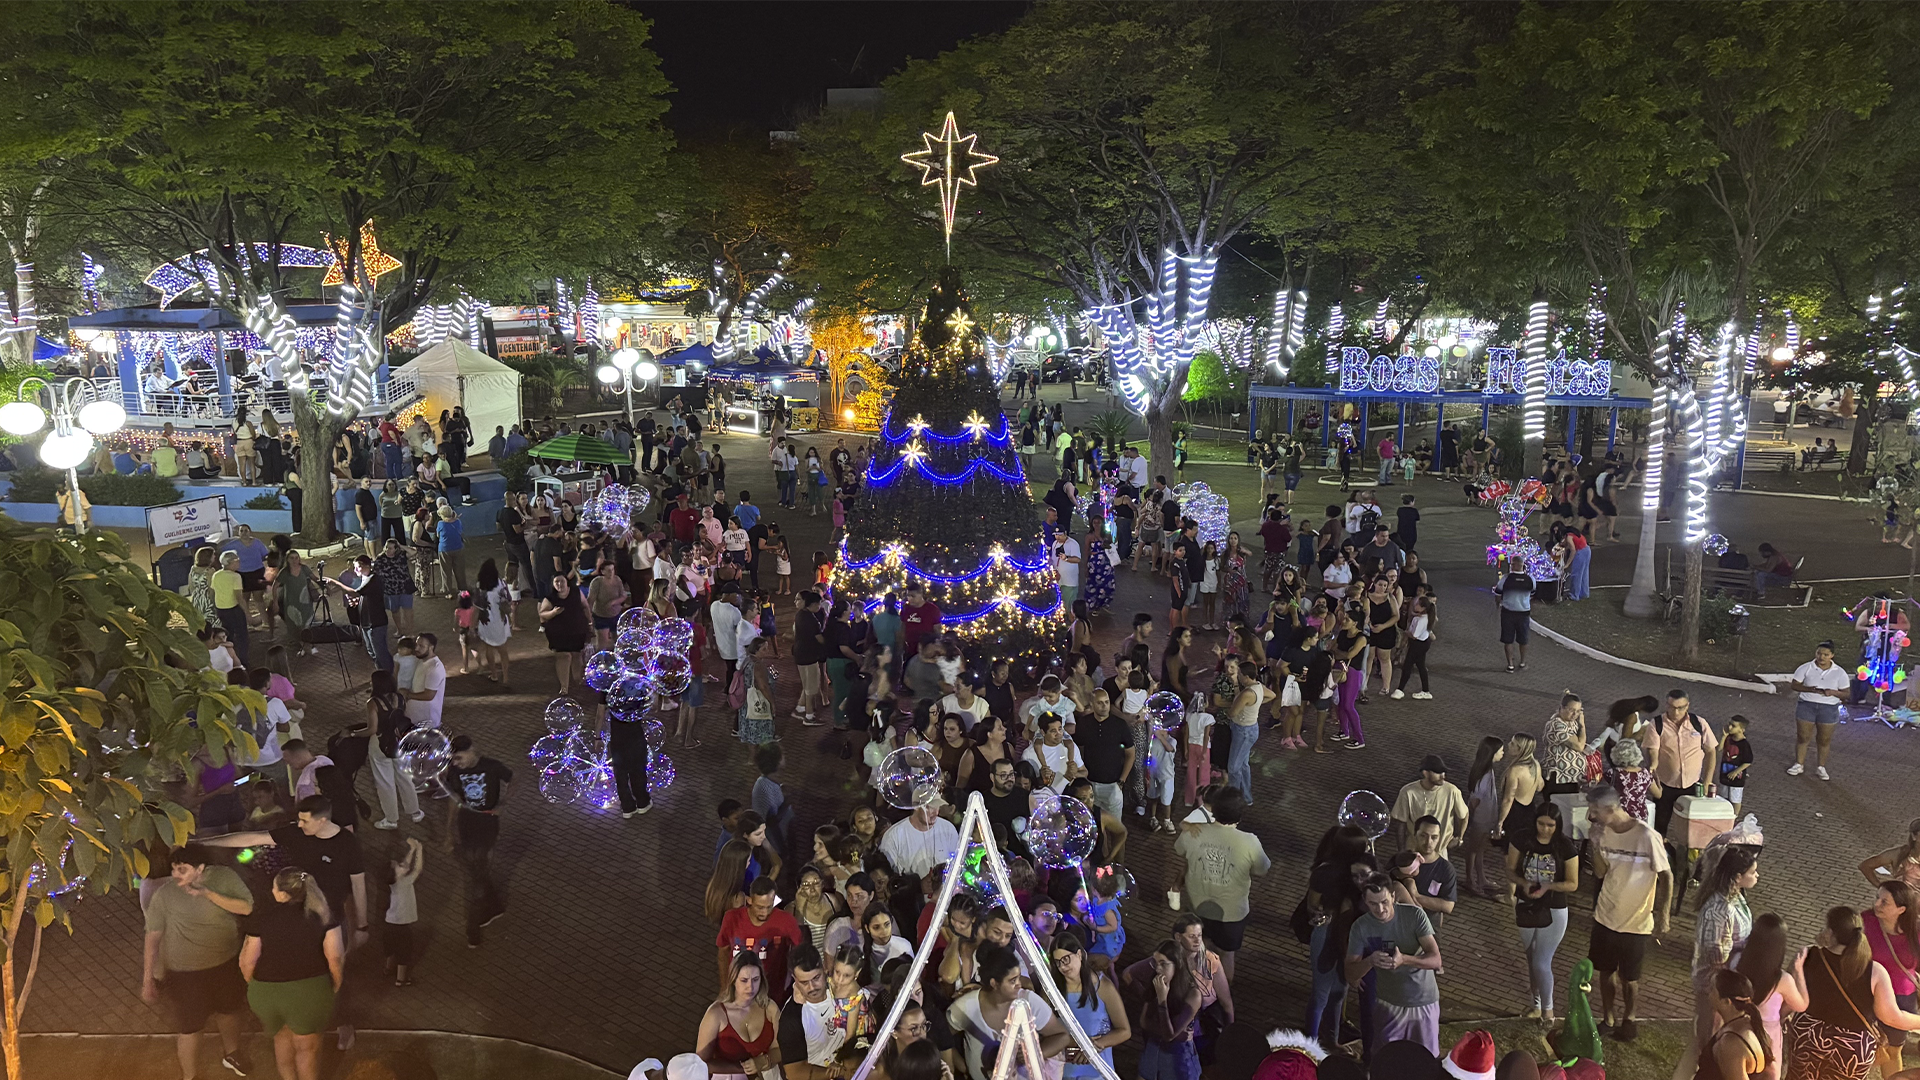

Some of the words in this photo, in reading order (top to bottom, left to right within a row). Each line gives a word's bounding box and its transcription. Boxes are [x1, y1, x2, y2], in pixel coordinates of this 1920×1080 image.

[1339, 347, 1440, 393] Boas
[164, 527, 194, 538] GUILHERME
[194, 524, 210, 532] GUIDO
